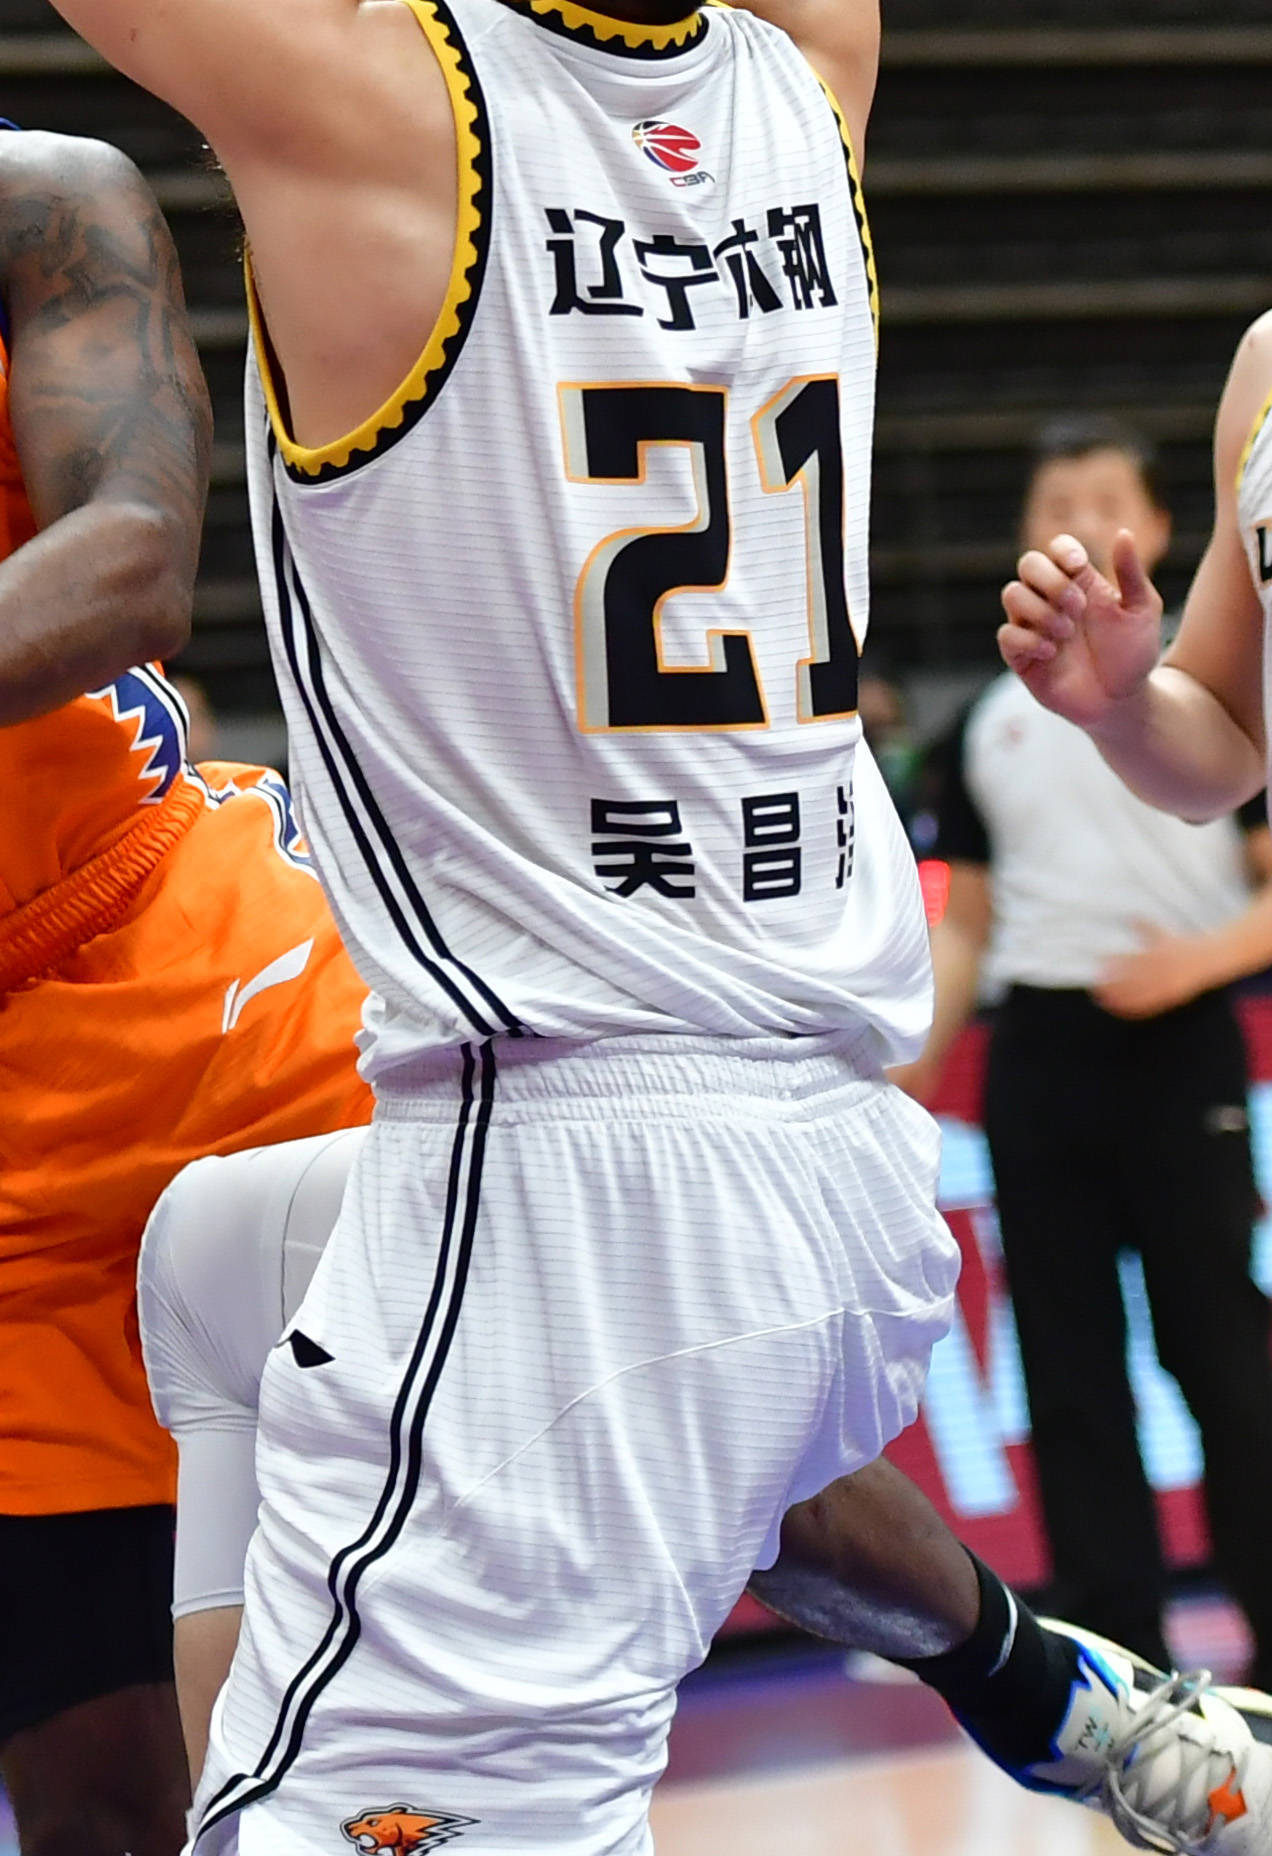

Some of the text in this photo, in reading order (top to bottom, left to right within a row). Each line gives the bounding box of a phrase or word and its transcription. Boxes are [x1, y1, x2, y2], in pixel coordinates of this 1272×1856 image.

[669, 171, 715, 187] CBA
[556, 373, 859, 734] 21
[590, 781, 855, 902] 吴昌
